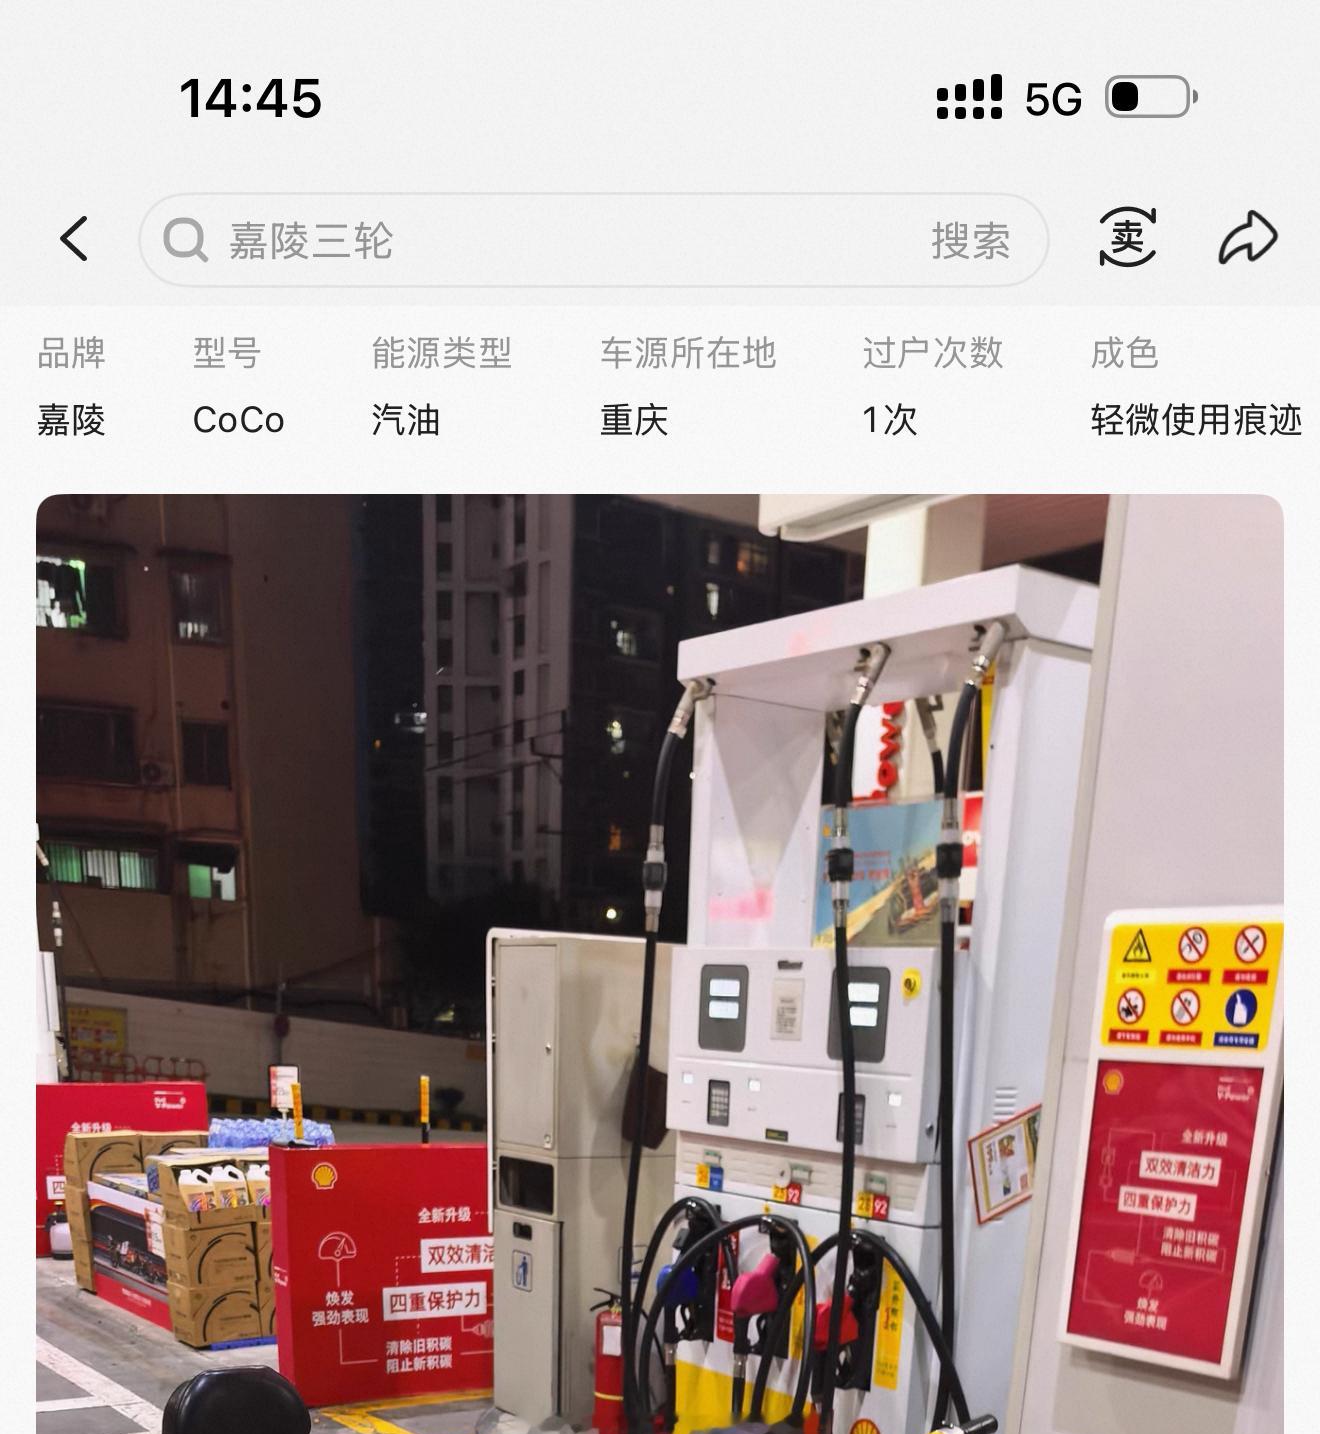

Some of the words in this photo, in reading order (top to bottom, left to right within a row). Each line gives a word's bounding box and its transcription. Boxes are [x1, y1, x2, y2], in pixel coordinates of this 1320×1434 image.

[1182, 1129, 1228, 1147] 全新升级
[1145, 1157, 1215, 1180] 双效清洁力
[787, 1187, 800, 1204] 92
[1123, 1190, 1191, 1215] 四重保护力
[418, 1207, 471, 1224] 全新升级
[874, 1200, 888, 1217] 92
[325, 1290, 354, 1307] 焕发
[390, 1289, 480, 1314] 四重保护力
[312, 1308, 369, 1327] 强劲表现
[386, 1336, 452, 1355] 清除旧积碳
[386, 1354, 452, 1374] 阻止新积碳
